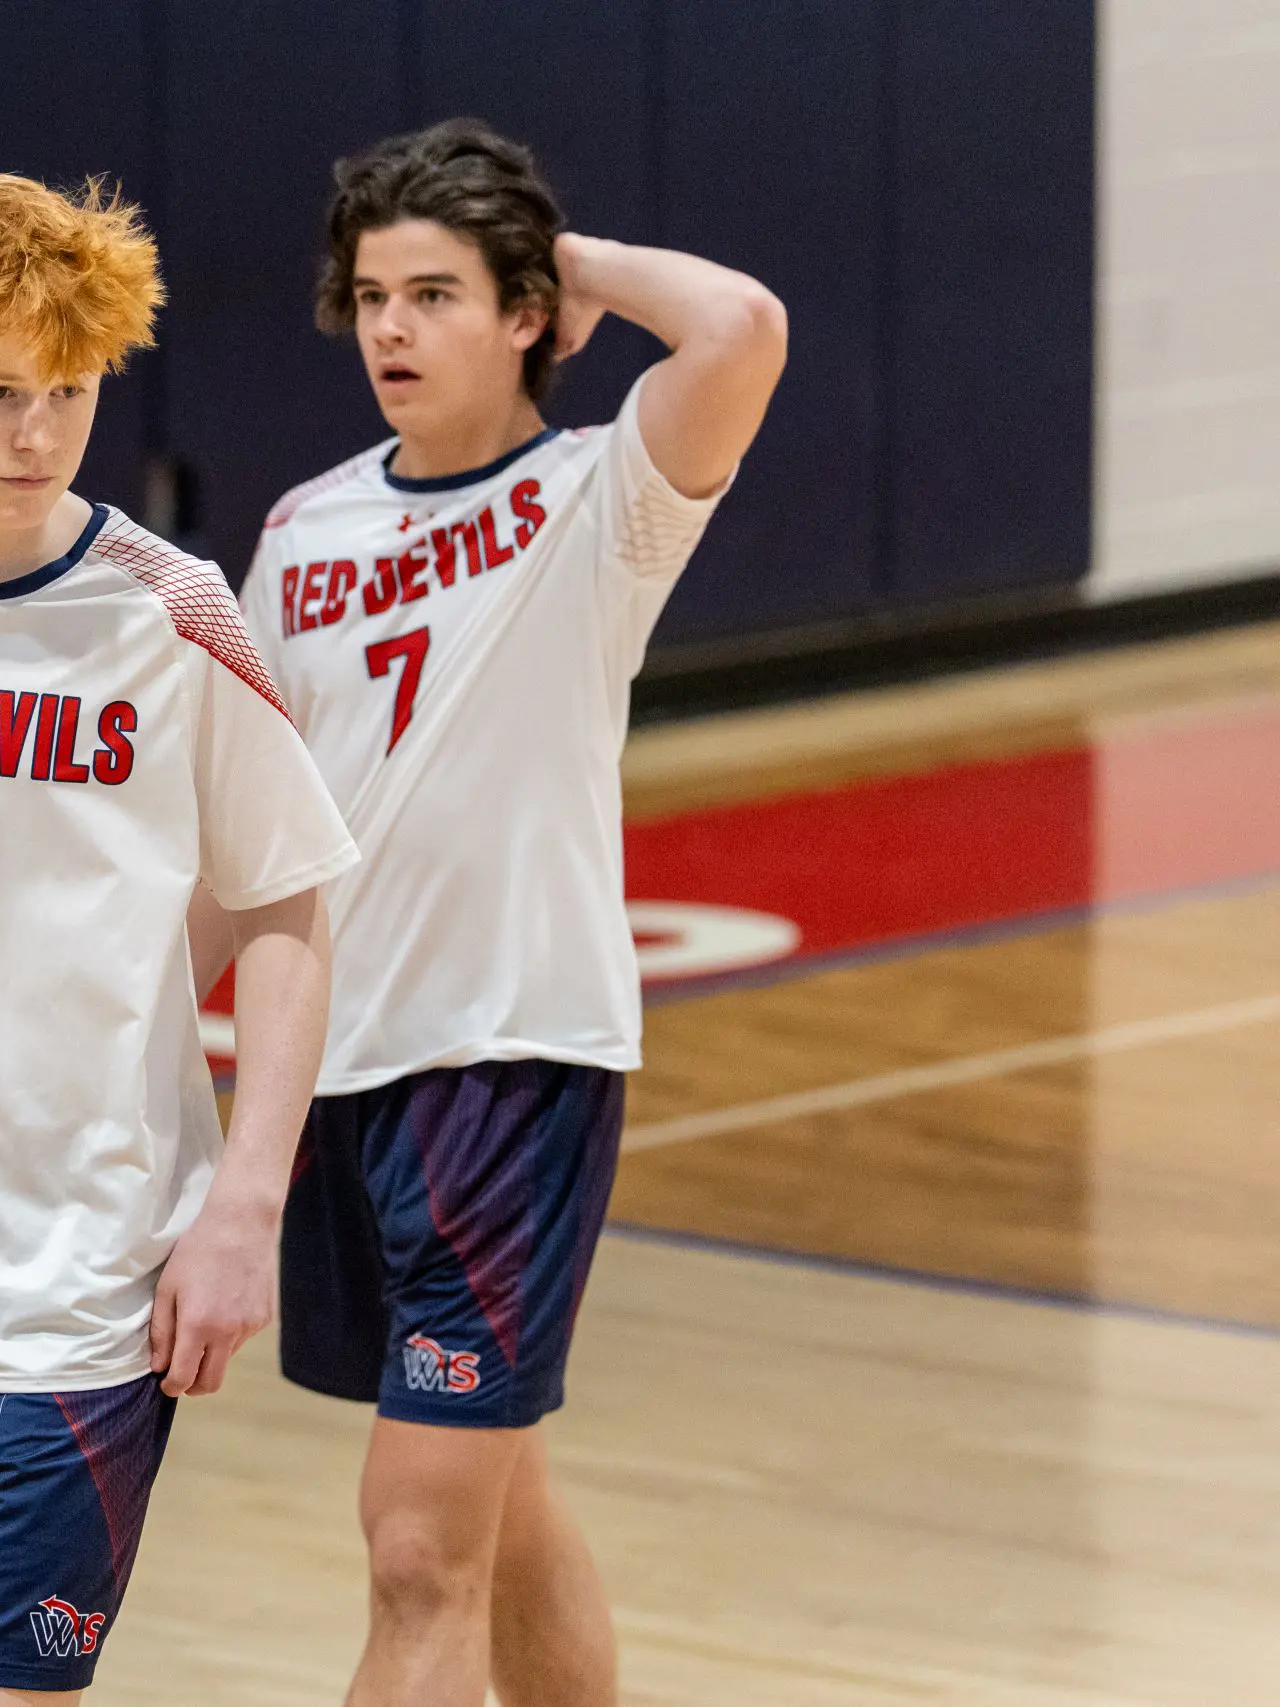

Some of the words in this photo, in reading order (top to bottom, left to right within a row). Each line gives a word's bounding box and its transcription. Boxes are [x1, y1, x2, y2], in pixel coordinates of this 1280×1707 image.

[282, 559, 358, 640] RED
[362, 478, 547, 617] DEVILS
[365, 625, 430, 757] 7
